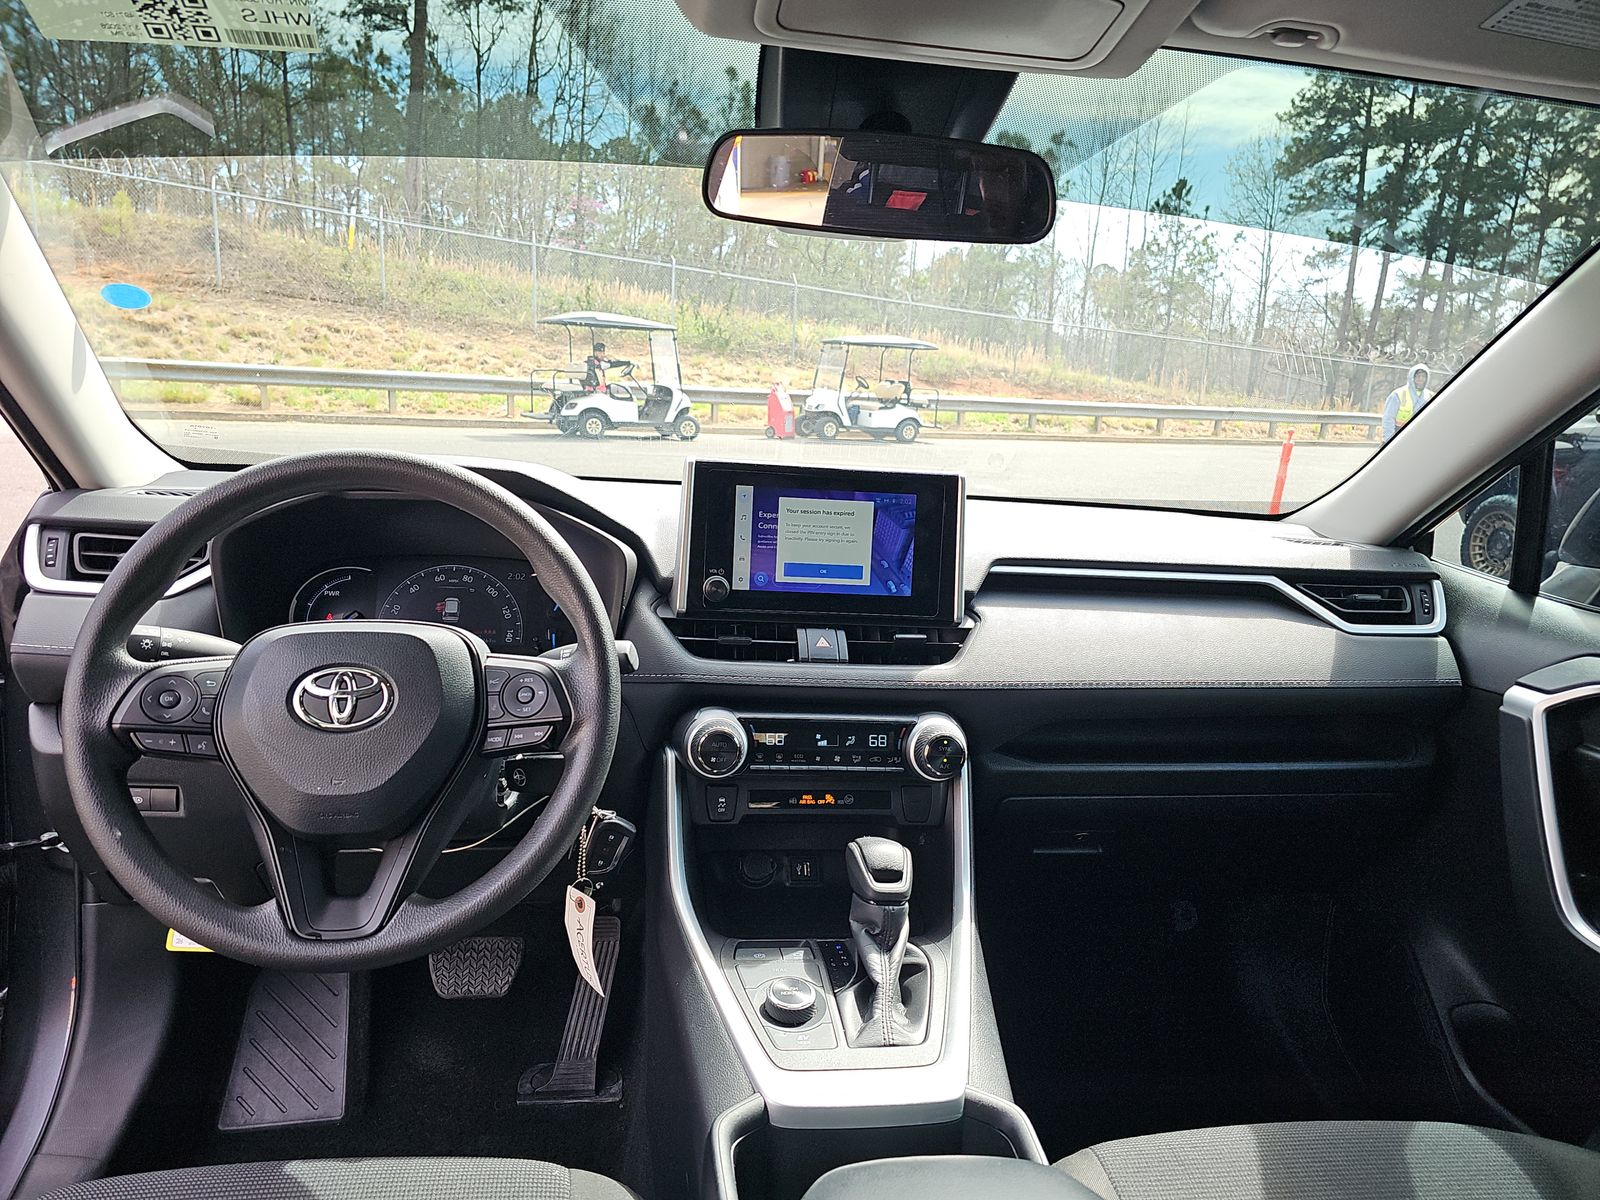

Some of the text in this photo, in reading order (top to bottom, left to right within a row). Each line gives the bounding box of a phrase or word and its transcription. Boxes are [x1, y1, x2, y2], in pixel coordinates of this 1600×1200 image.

[434, 574, 446, 583] 60
[462, 574, 474, 583] 80
[508, 572, 526, 581] 2:02
[409, 584, 420, 594] 40
[484, 584, 499, 598] 100
[391, 604, 401, 616] 20
[502, 605, 512, 620] 120
[505, 629, 514, 643] 140
[766, 734, 784, 746] 68
[869, 734, 887, 747] 68
